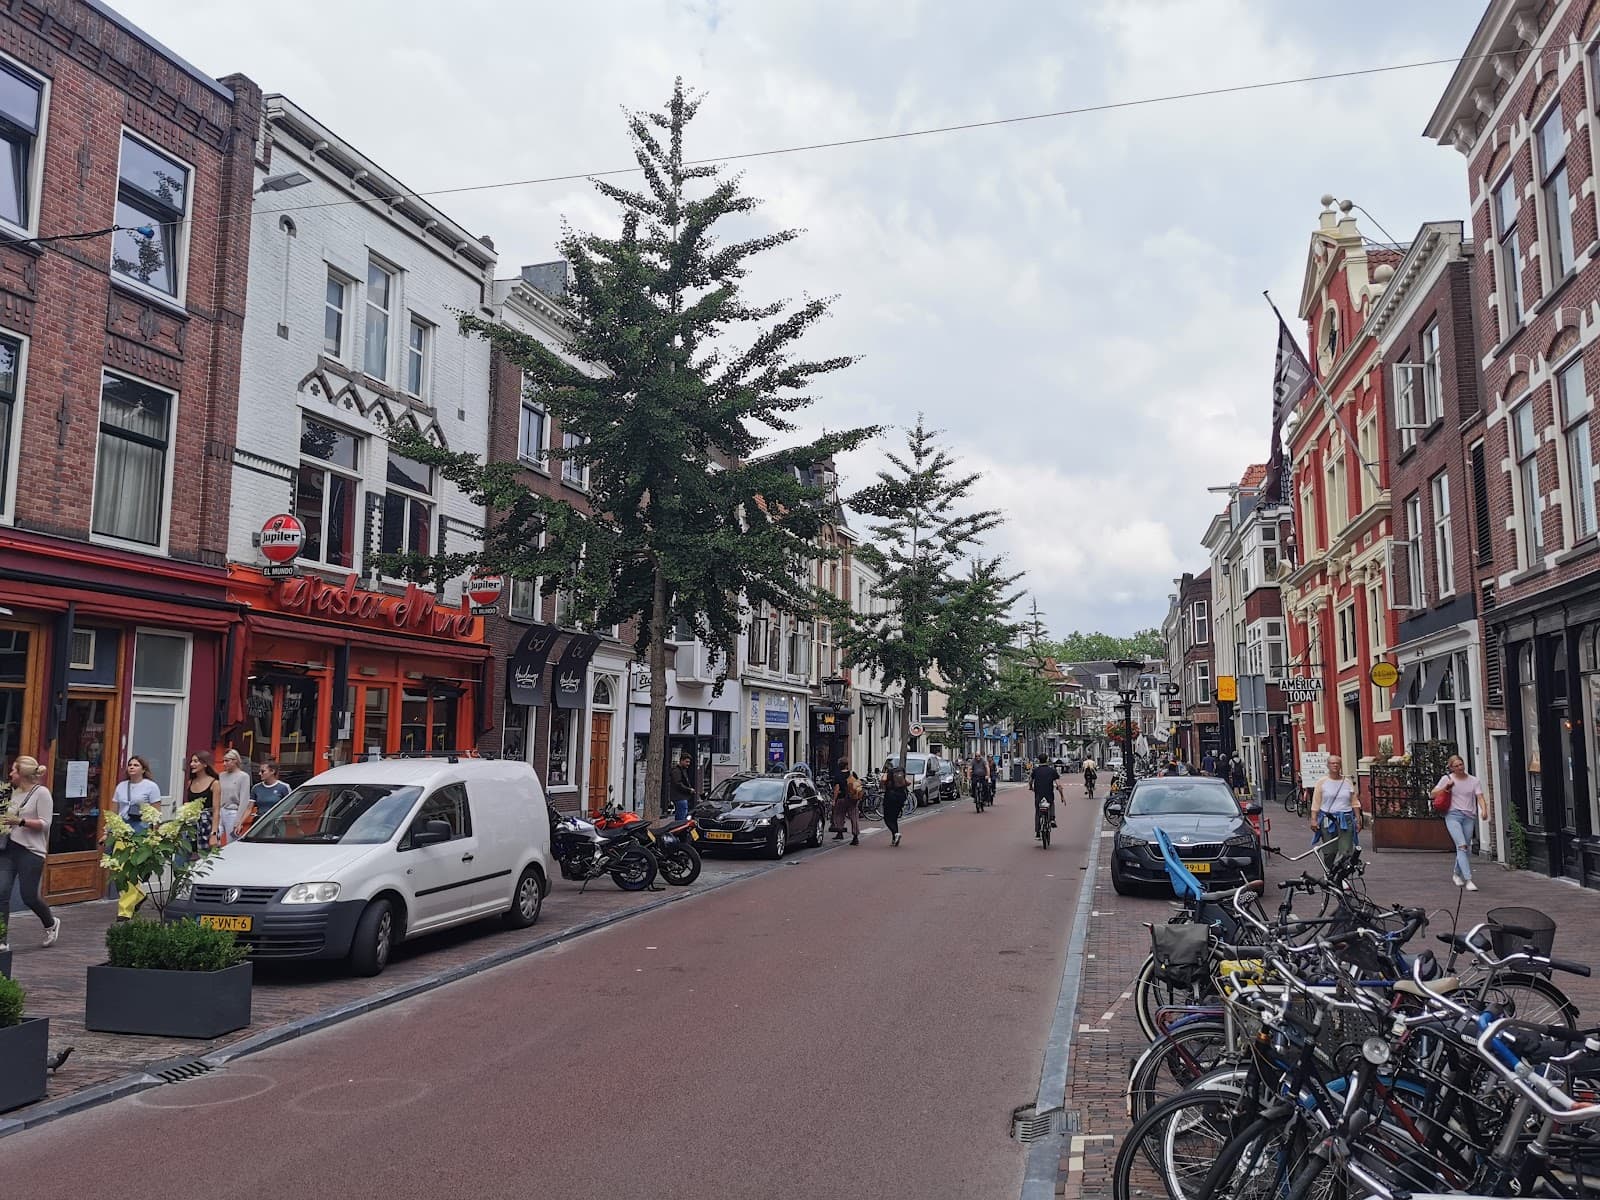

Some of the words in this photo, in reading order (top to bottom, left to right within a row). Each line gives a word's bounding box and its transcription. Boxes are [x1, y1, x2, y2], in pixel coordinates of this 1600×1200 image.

[262, 531, 299, 544] Jupiler
[263, 567, 271, 576] EL
[272, 567, 293, 576] MUNDO
[471, 580, 500, 591] Jupiler
[1281, 680, 1321, 690] AMERICA
[1289, 691, 1316, 701] TODAY
